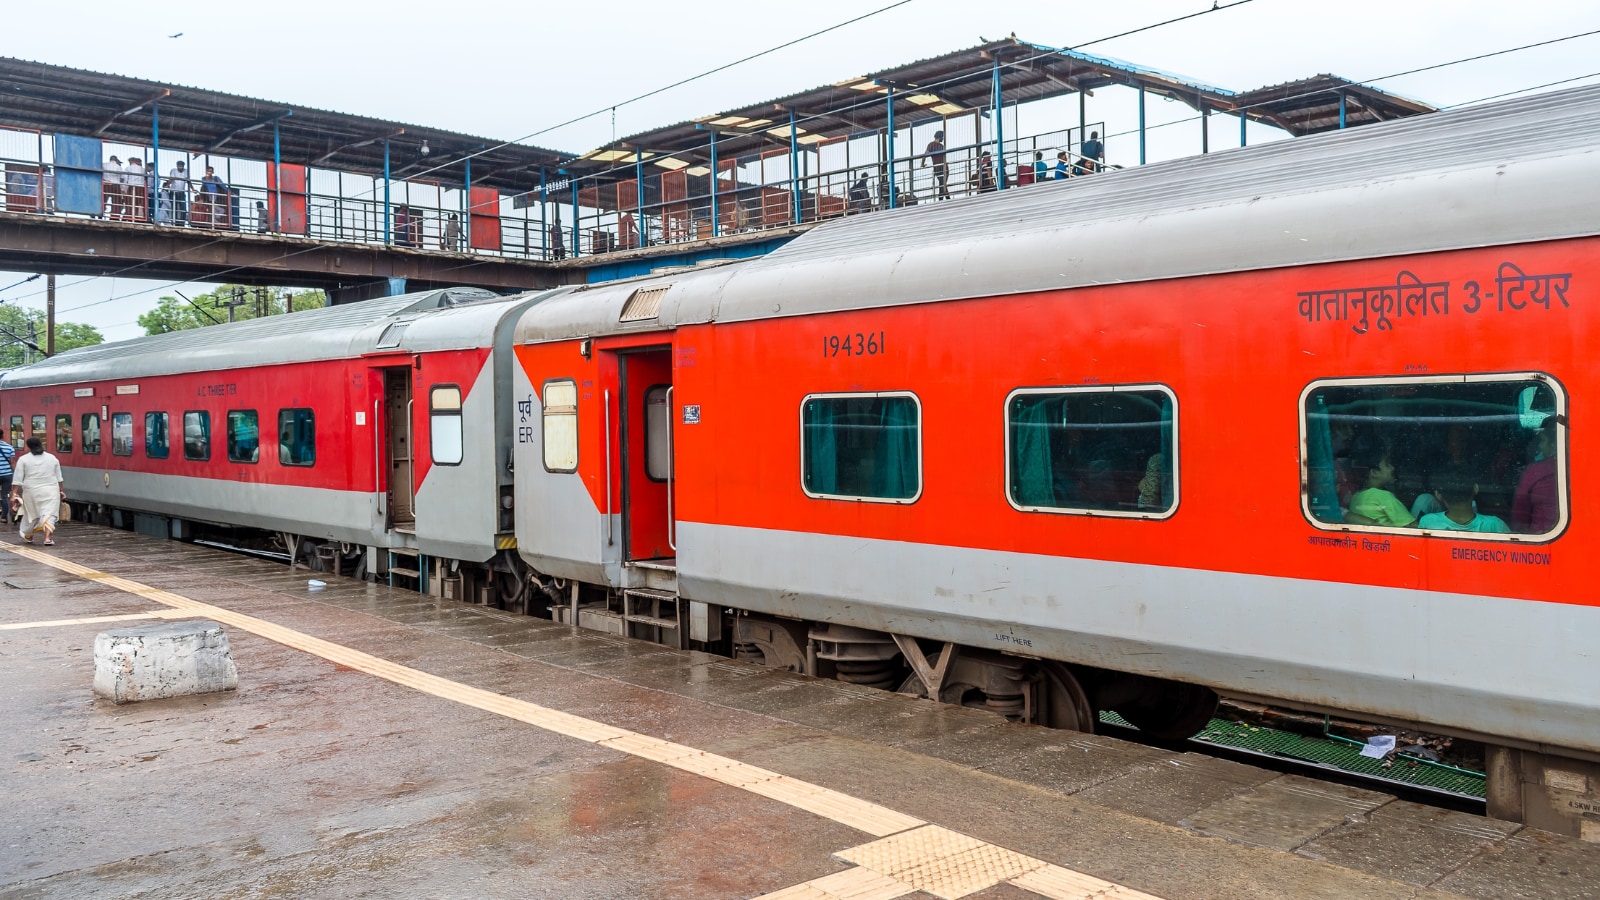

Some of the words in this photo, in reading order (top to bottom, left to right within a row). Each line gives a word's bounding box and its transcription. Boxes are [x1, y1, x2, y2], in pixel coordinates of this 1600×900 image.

[1297, 270, 1450, 334] वातानुकूलित
[1463, 262, 1573, 314] 3-टियर
[823, 331, 885, 358] 194361
[207, 384, 225, 396] THREE
[518, 394, 532, 423] पूर्व
[519, 427, 534, 443] ER
[1452, 548, 1508, 562] EMERGENCY
[1510, 552, 1551, 565] WINDOW
[995, 633, 1009, 642] LIFT
[1012, 637, 1032, 647] HERE
